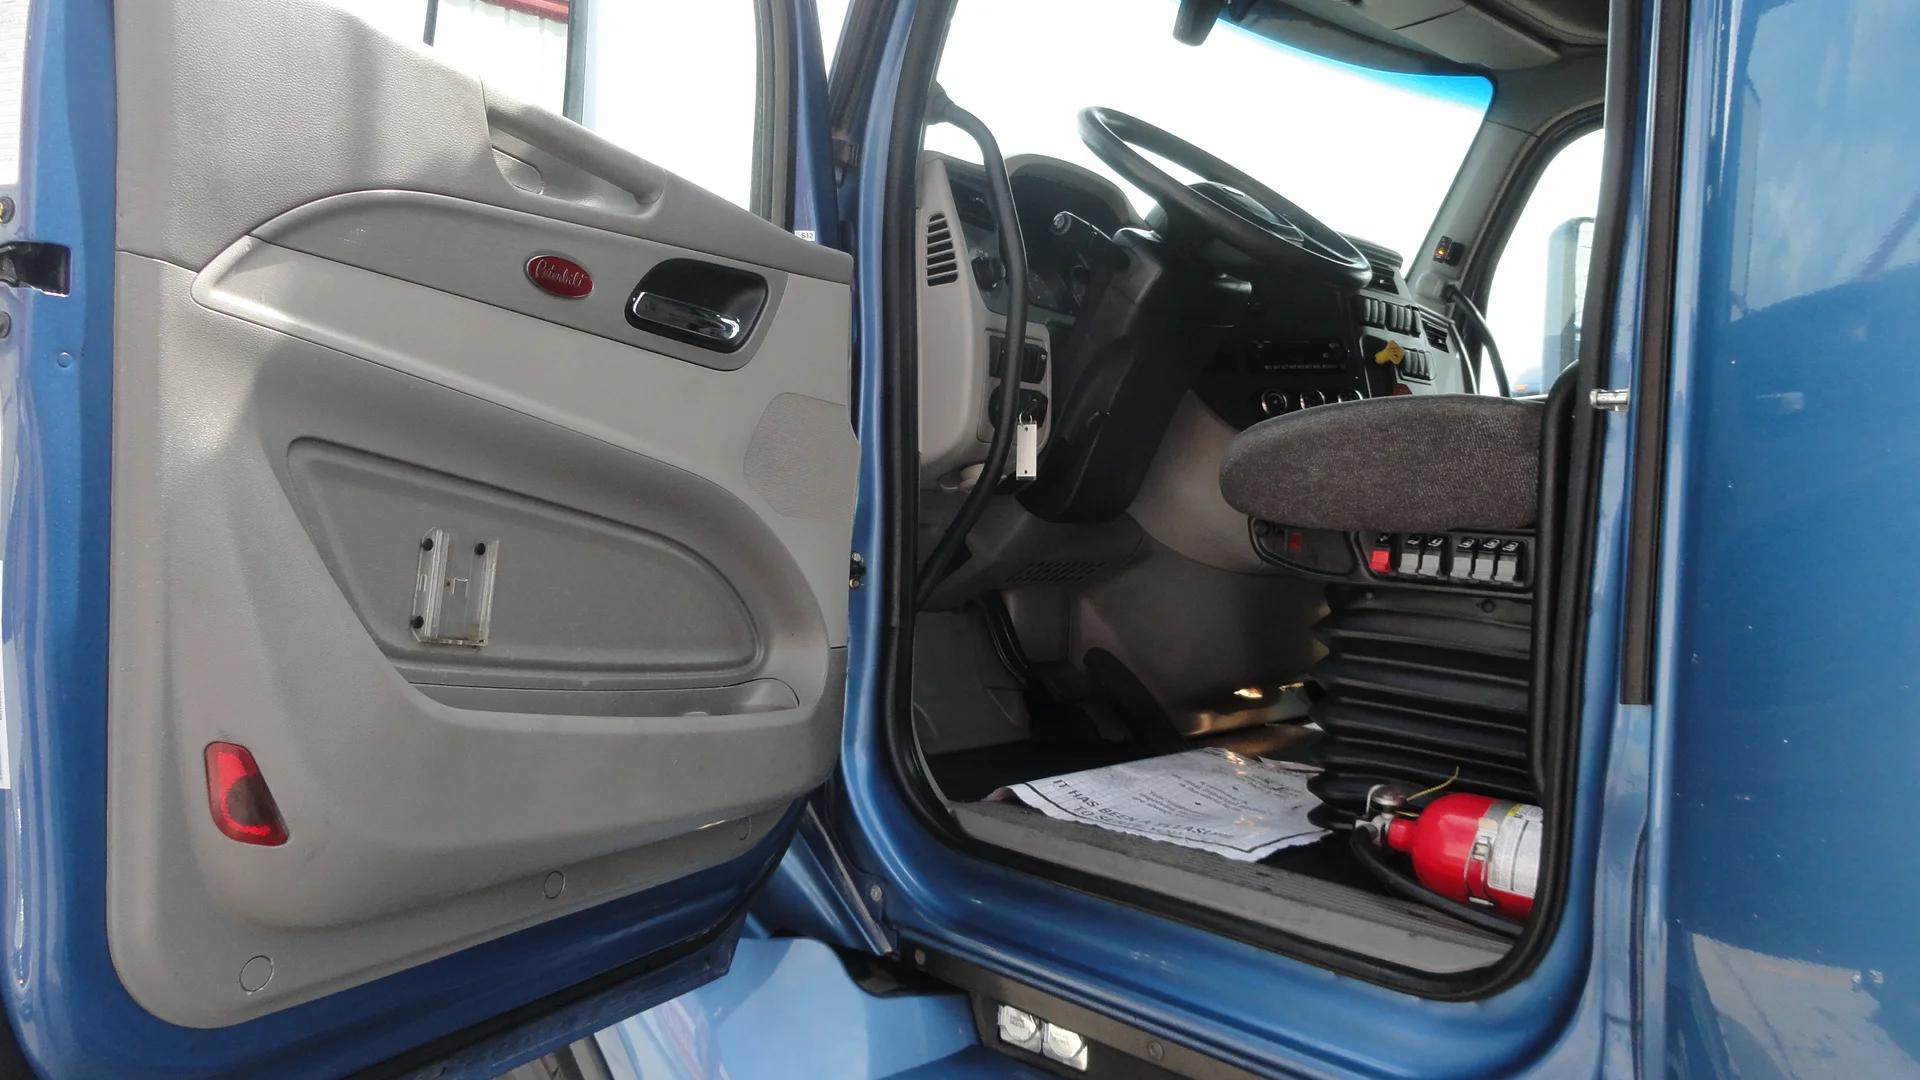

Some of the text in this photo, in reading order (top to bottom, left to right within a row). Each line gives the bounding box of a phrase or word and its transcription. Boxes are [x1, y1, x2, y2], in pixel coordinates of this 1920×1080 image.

[1053, 779, 1070, 789] IT
[1068, 790, 1100, 807] HAS
[1074, 806, 1095, 816] TO
